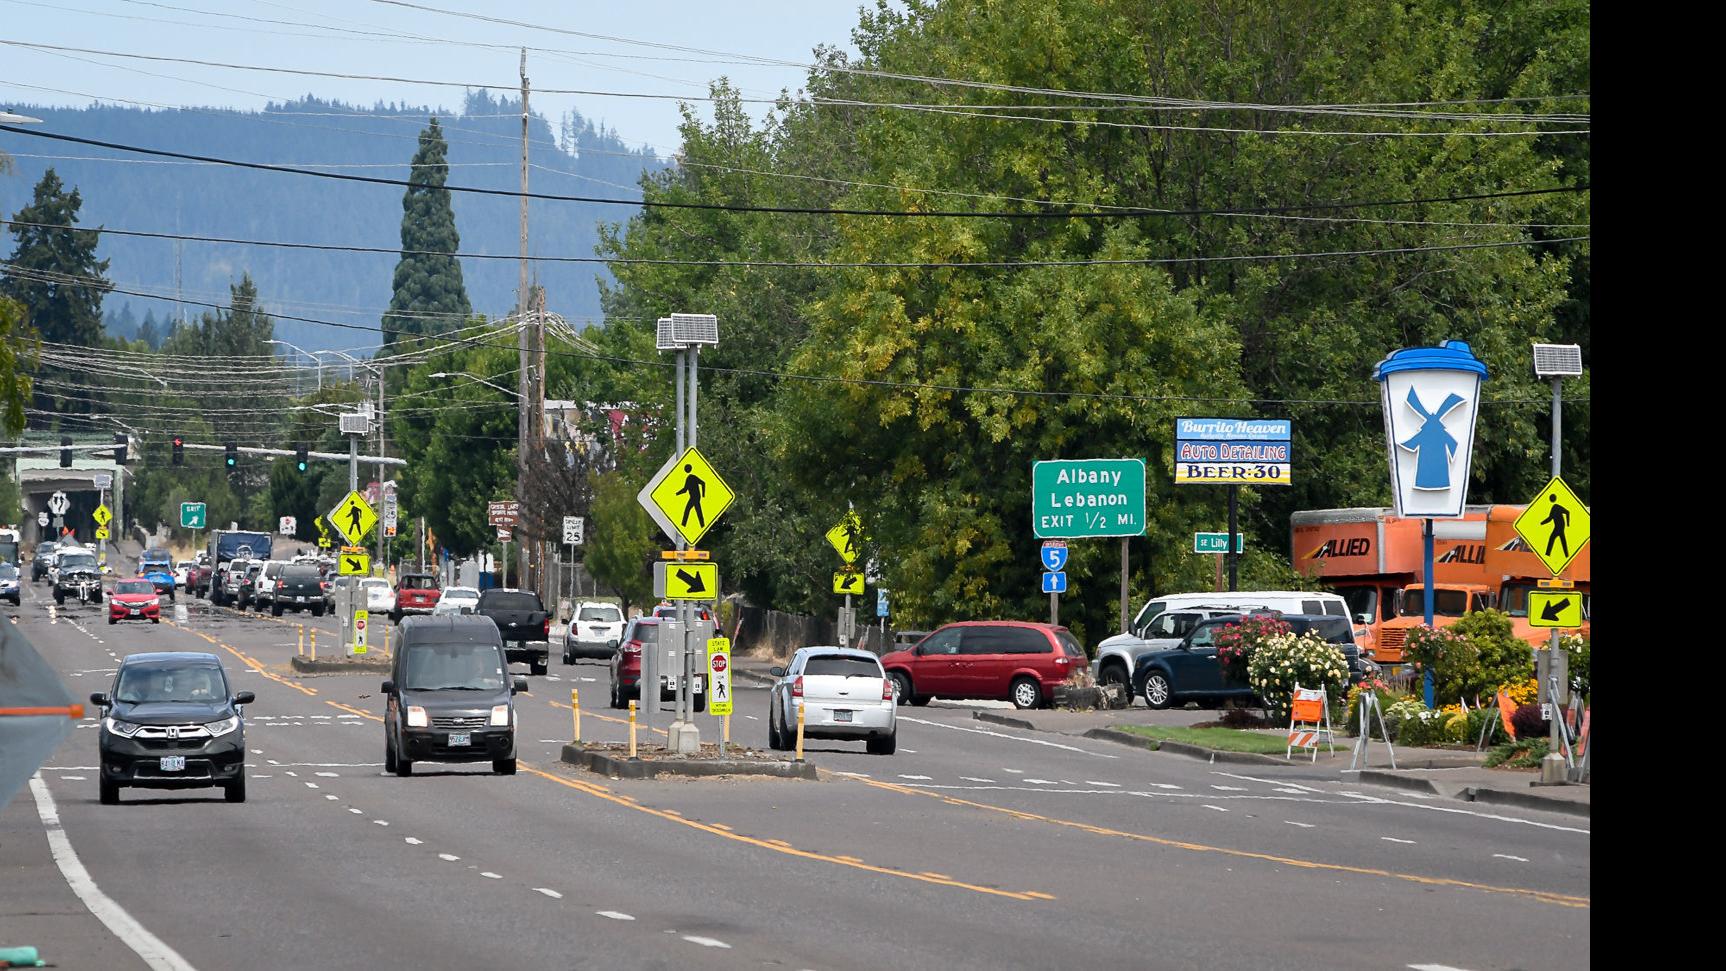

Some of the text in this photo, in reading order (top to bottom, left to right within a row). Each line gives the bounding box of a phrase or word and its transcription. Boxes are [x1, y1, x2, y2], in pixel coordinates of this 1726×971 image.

[1182, 420, 1286, 434] Burrito Heaven
[1181, 443, 1286, 460] AUTO DETAILING
[1056, 468, 1121, 487] Albany
[1186, 465, 1281, 480] BEER:30
[1051, 492, 1127, 508] Lebanon
[1041, 515, 1074, 528] EXIT
[1117, 513, 1136, 525] MI.
[566, 531, 580, 541] 25
[1211, 538, 1227, 549] Lilly
[1312, 538, 1371, 558] ALLIED
[1049, 550, 1060, 568] 5
[712, 660, 726, 668] STOP
